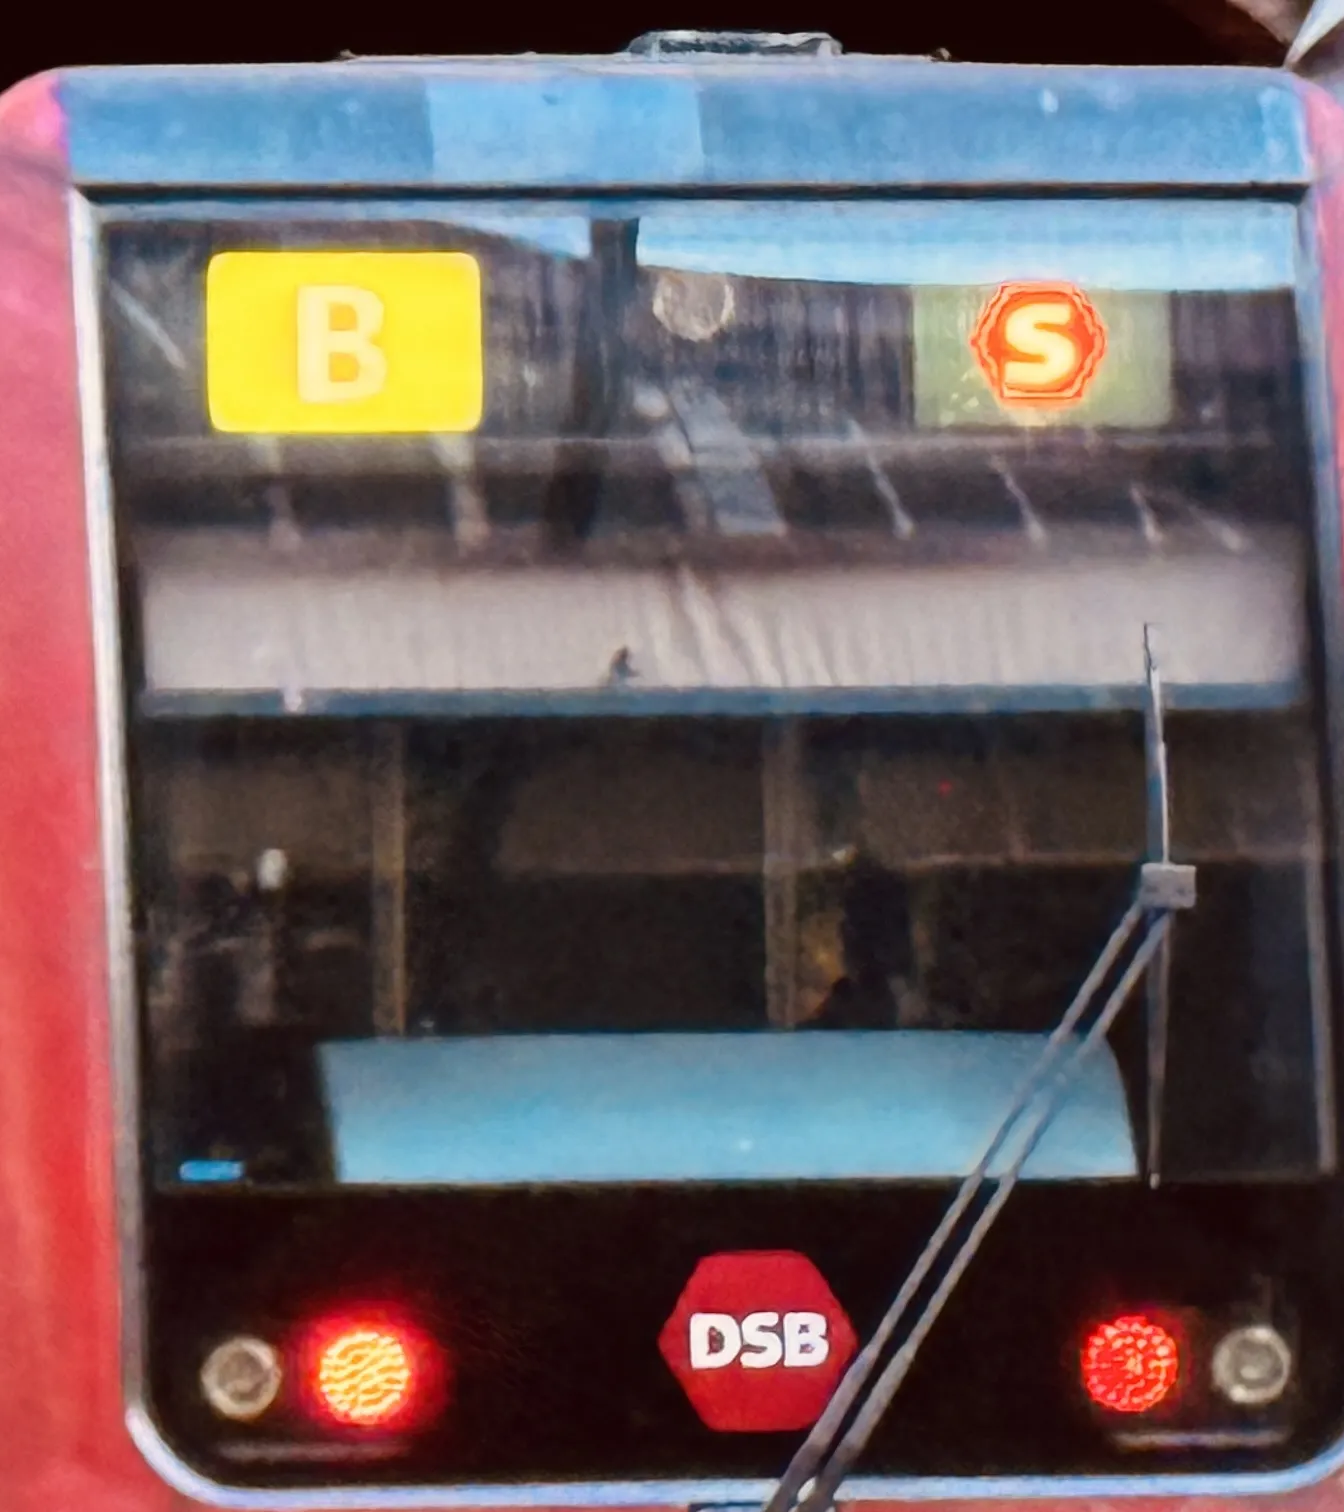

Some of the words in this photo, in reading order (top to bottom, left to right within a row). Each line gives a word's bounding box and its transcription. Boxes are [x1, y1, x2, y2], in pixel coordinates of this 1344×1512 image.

[296, 284, 388, 404] B
[1005, 302, 1076, 385] S
[689, 1311, 829, 1369] DSB
